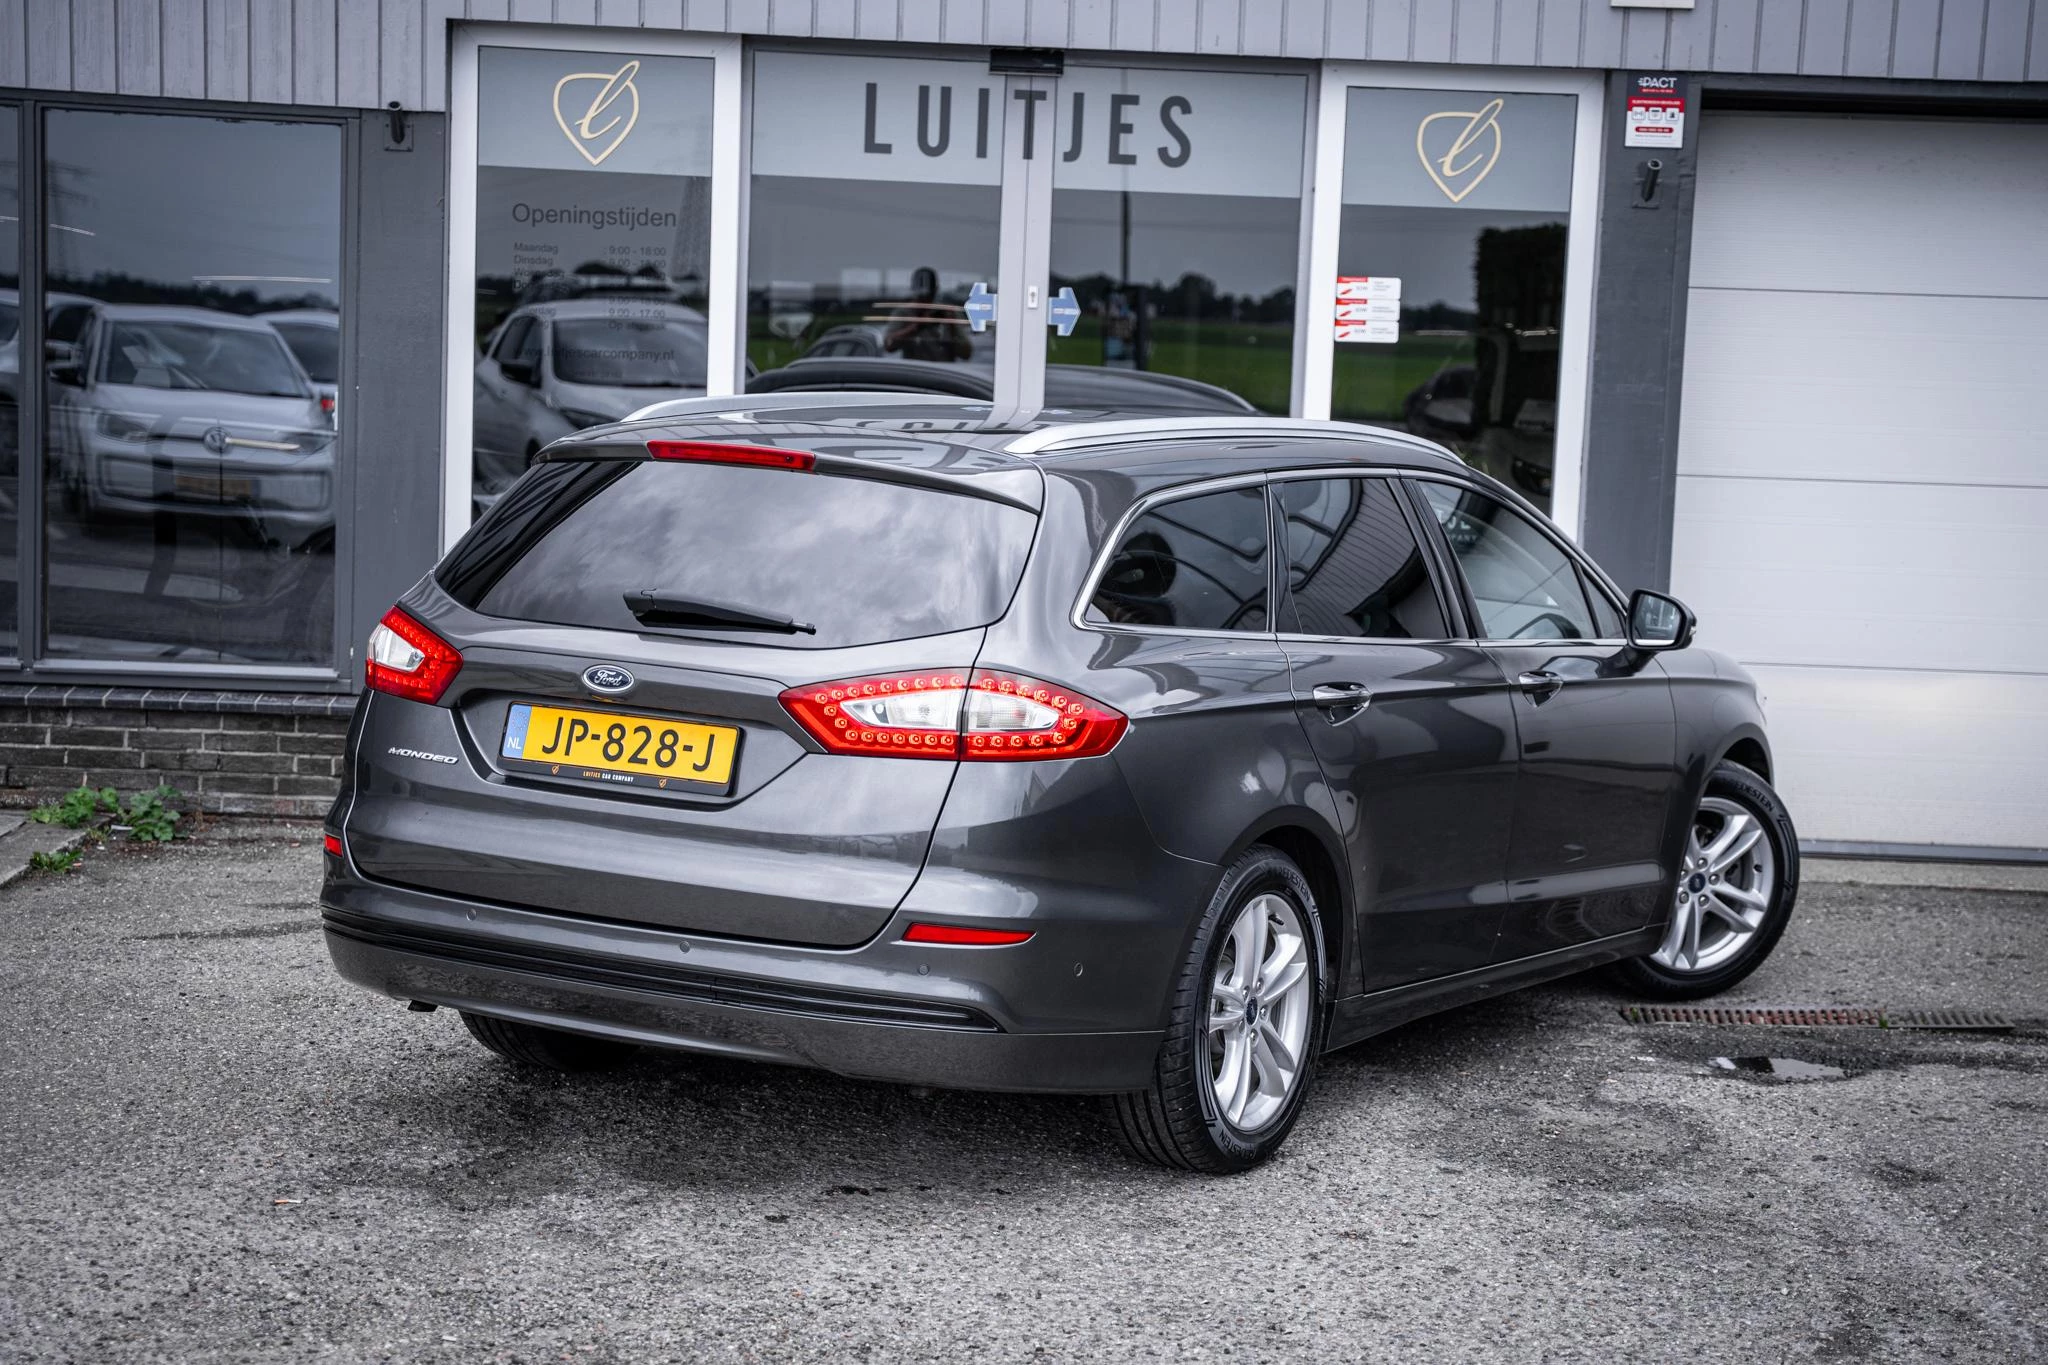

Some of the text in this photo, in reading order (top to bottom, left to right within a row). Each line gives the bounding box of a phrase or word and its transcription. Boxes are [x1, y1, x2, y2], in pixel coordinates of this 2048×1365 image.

[864, 82, 1192, 168] LUITJES
[512, 203, 677, 230] Openingstijden
[513, 255, 553, 267] Dinsdag
[594, 670, 623, 686] Ford
[507, 736, 522, 750] NL
[542, 717, 715, 772] JP-828-J
[388, 747, 459, 764] MONDEO
